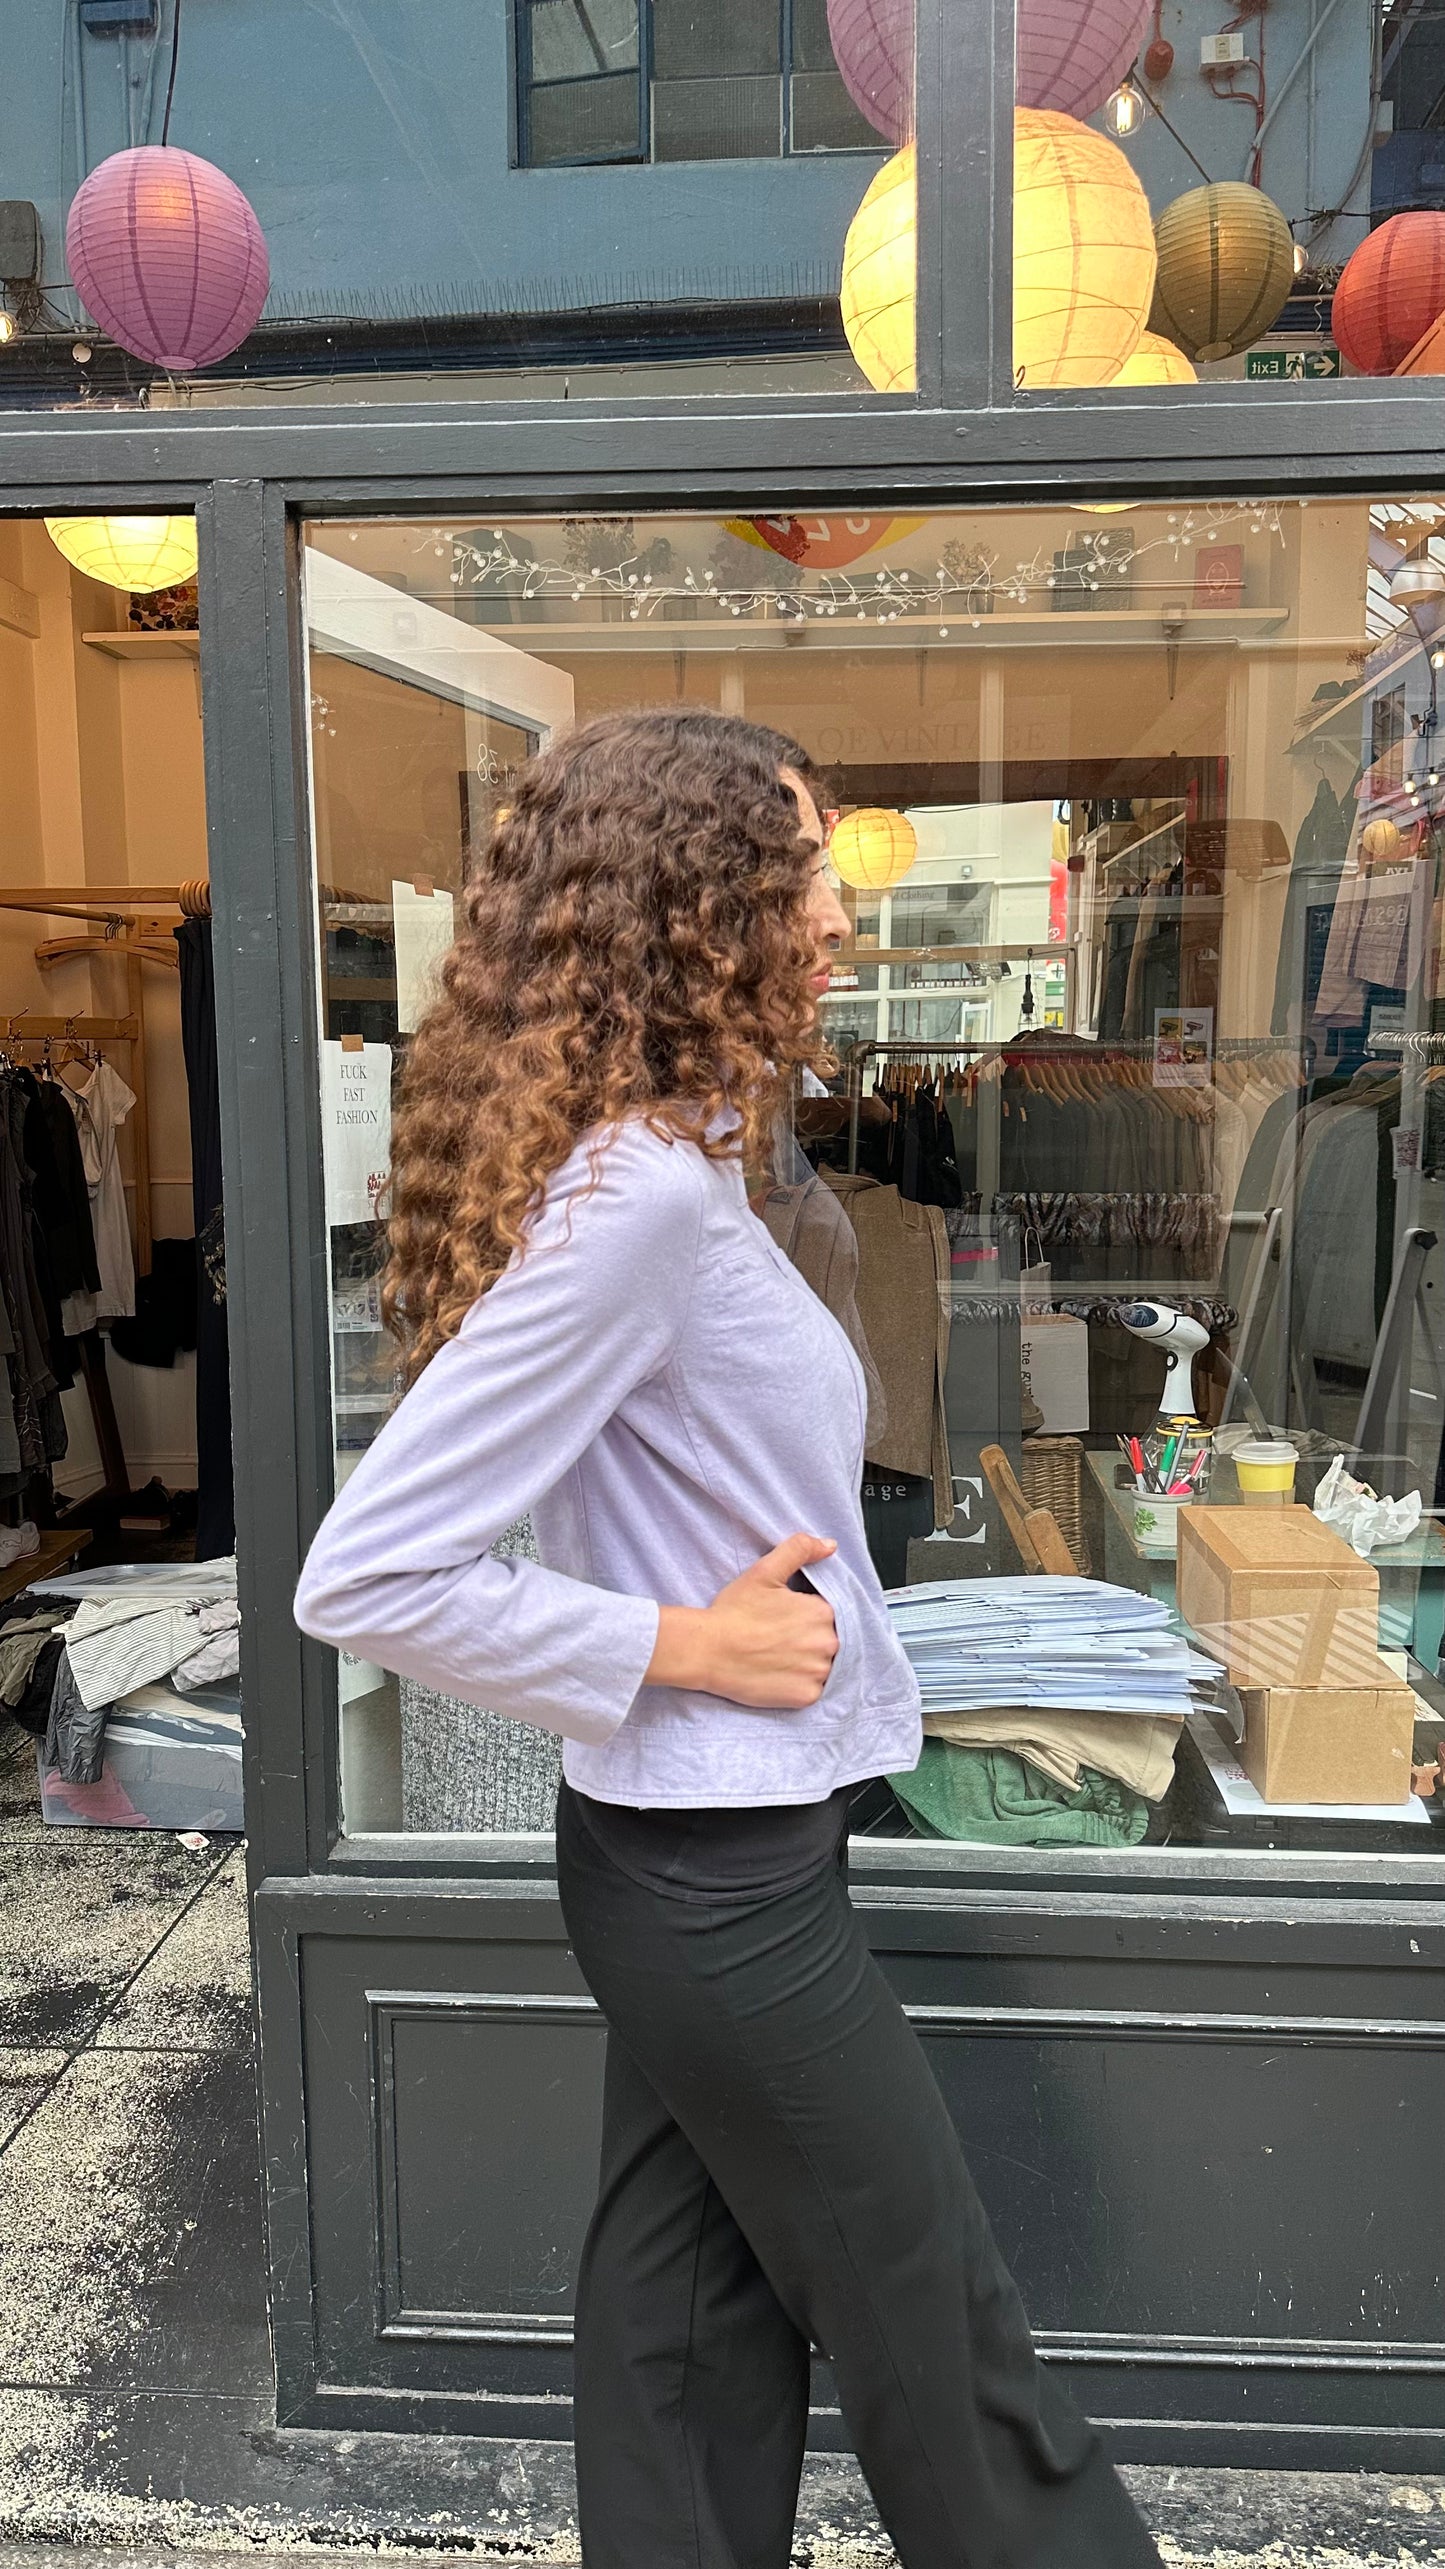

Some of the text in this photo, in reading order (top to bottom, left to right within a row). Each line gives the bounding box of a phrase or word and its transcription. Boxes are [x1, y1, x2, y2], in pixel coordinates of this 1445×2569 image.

[340, 1064, 367, 1080] FUCK
[343, 1087, 366, 1102] FAST
[336, 1109, 378, 1125] FASHION
[368, 1197, 387, 1210] SLE
[1021, 1341, 1033, 1365] the
[923, 1474, 987, 1544] E
